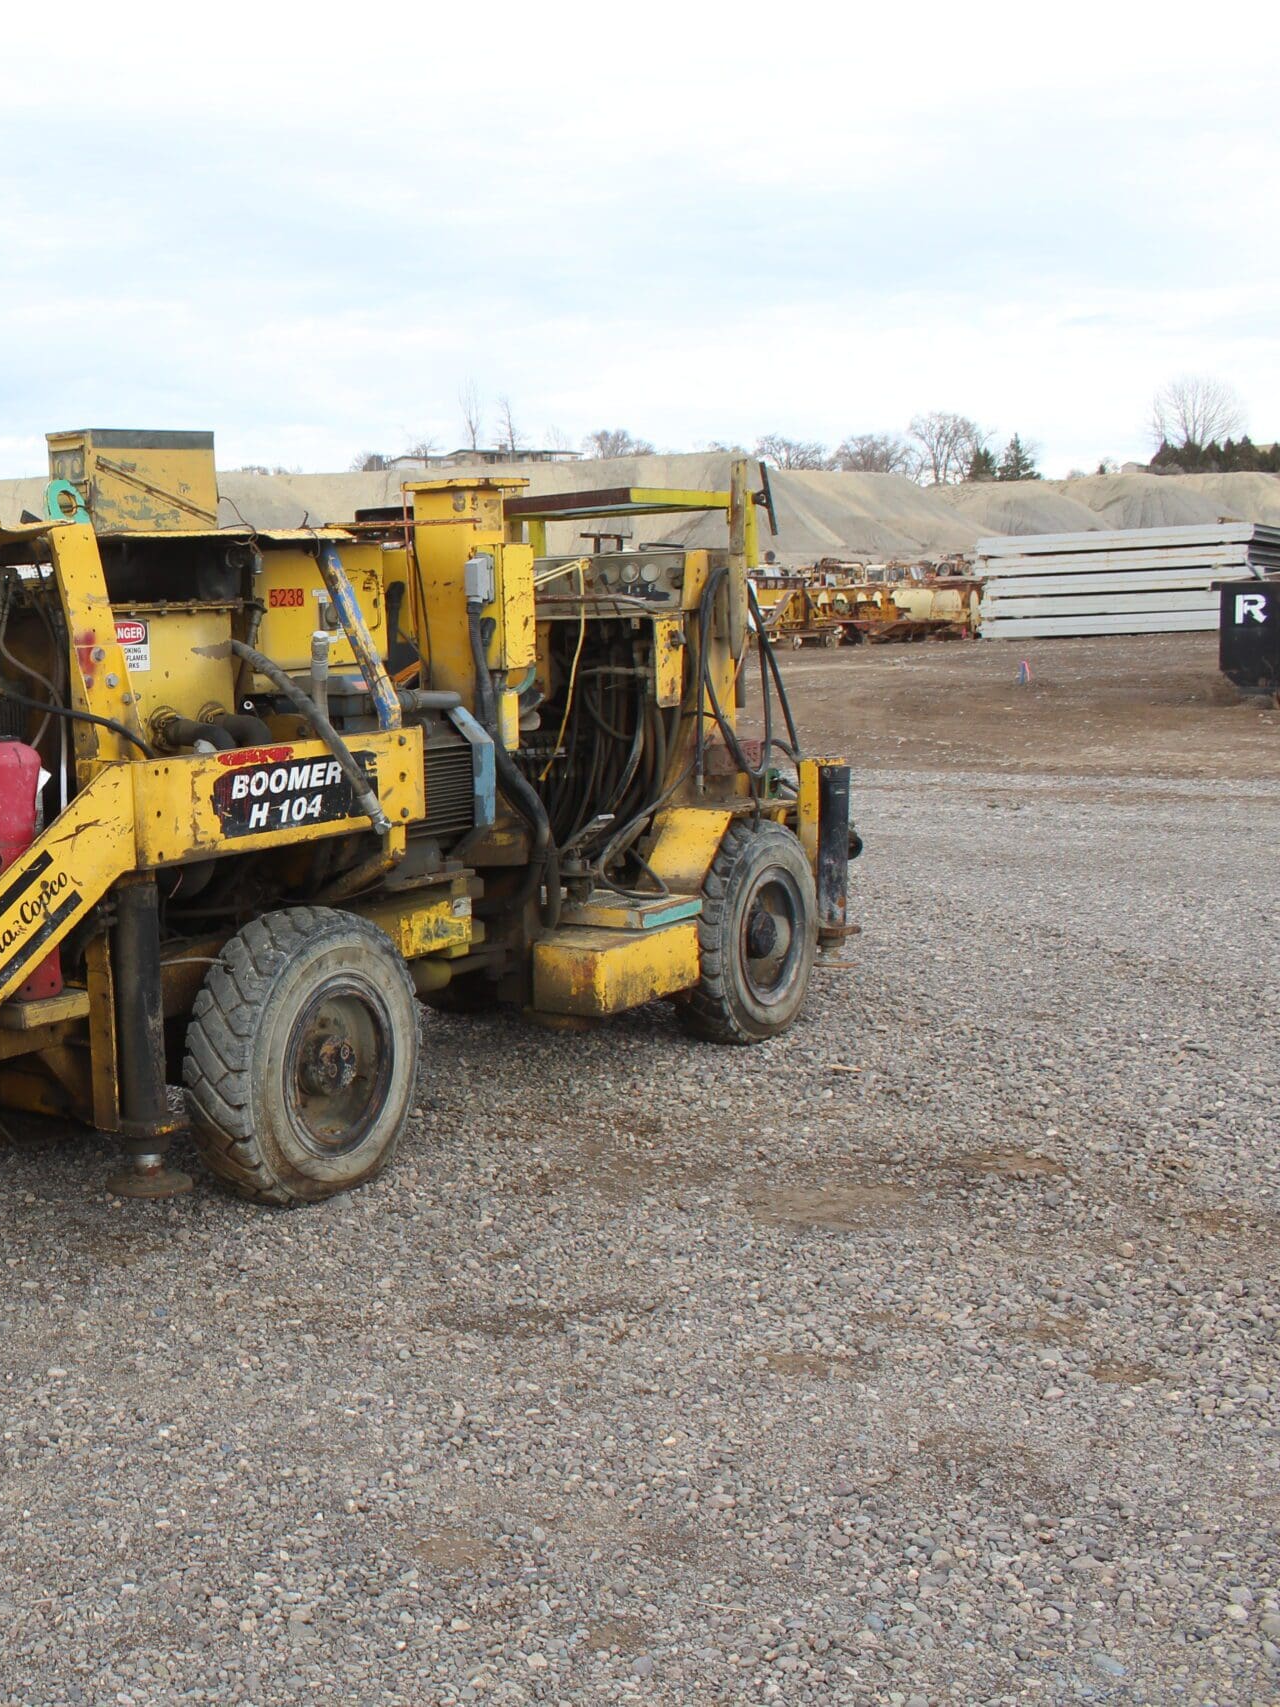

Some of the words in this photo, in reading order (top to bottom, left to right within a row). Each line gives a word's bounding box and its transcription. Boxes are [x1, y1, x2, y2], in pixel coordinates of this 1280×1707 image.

[270, 589, 304, 607] 5238
[117, 627, 142, 639] NGER
[231, 761, 342, 799] BOOMER
[249, 802, 270, 829] H
[279, 794, 323, 824] 104
